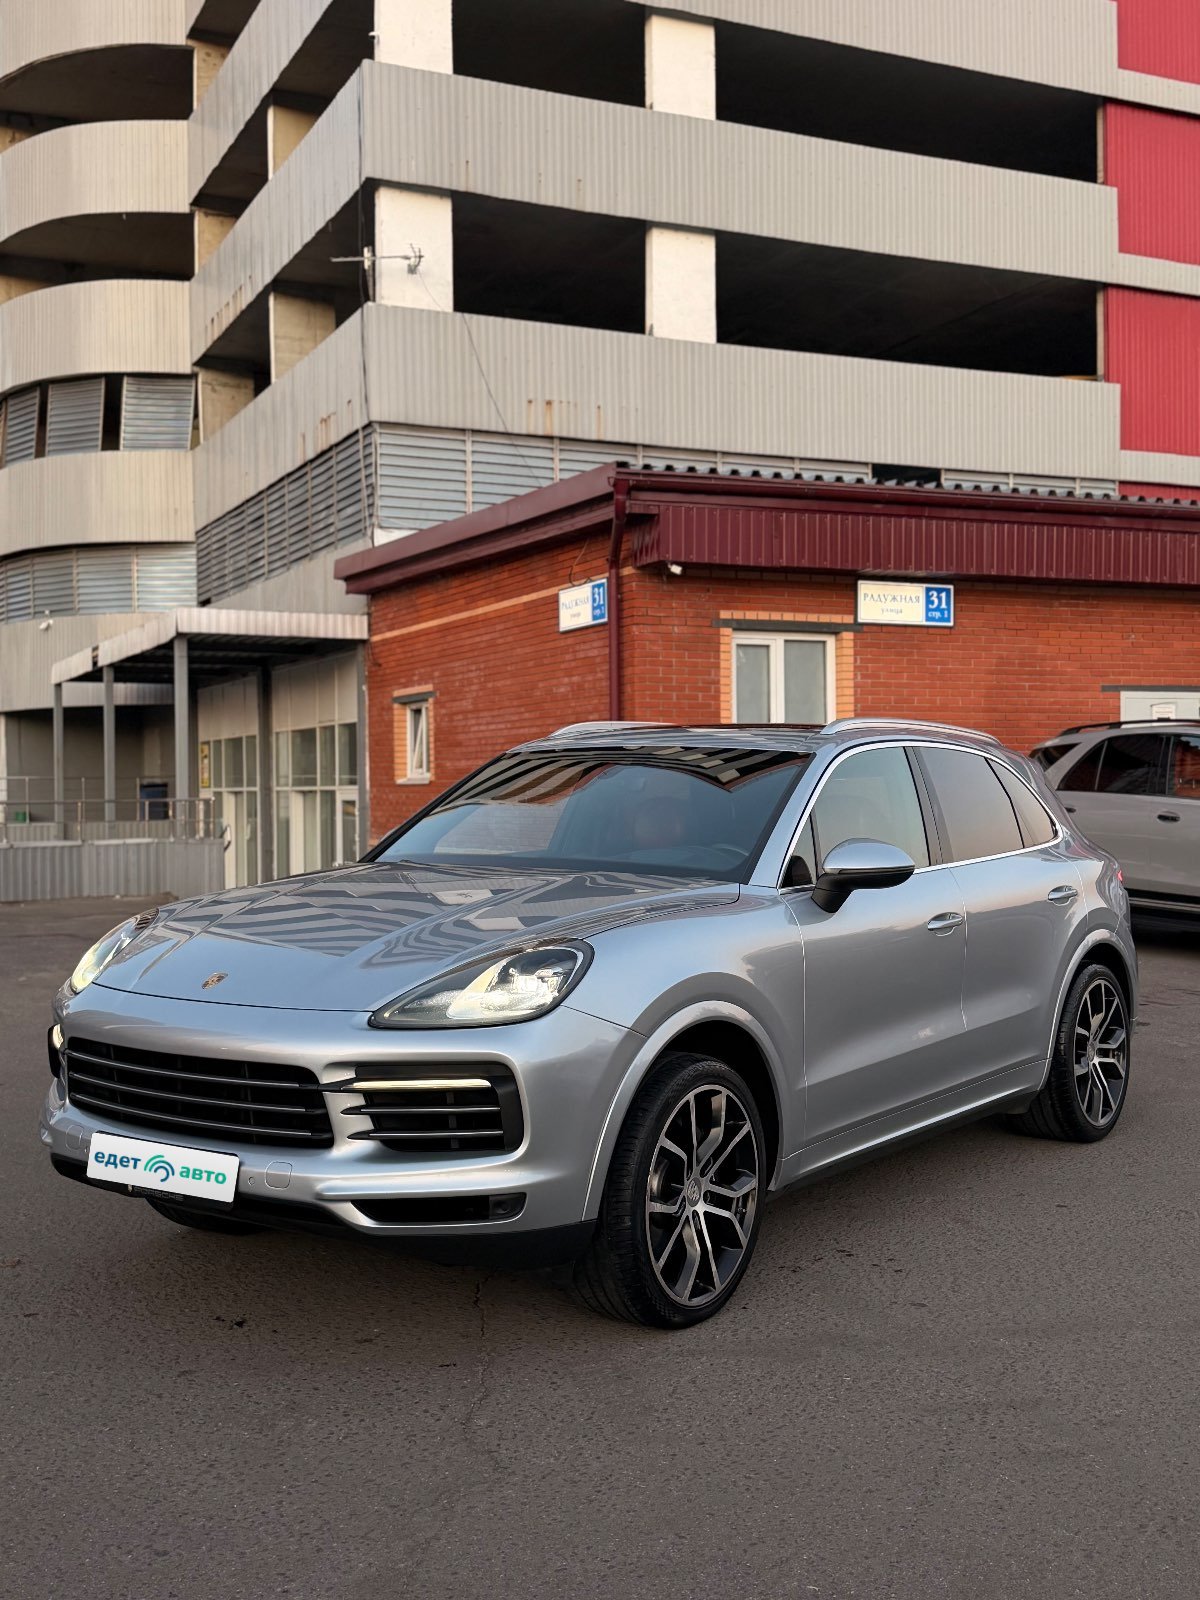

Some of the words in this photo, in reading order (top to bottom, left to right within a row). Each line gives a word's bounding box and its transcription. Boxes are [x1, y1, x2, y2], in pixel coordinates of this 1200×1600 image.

[593, 586, 604, 607] 31
[863, 592, 921, 604] РАДУЖНАЯ
[928, 590, 948, 609] 31
[94, 1151, 142, 1170] едет
[179, 1165, 227, 1185] авто
